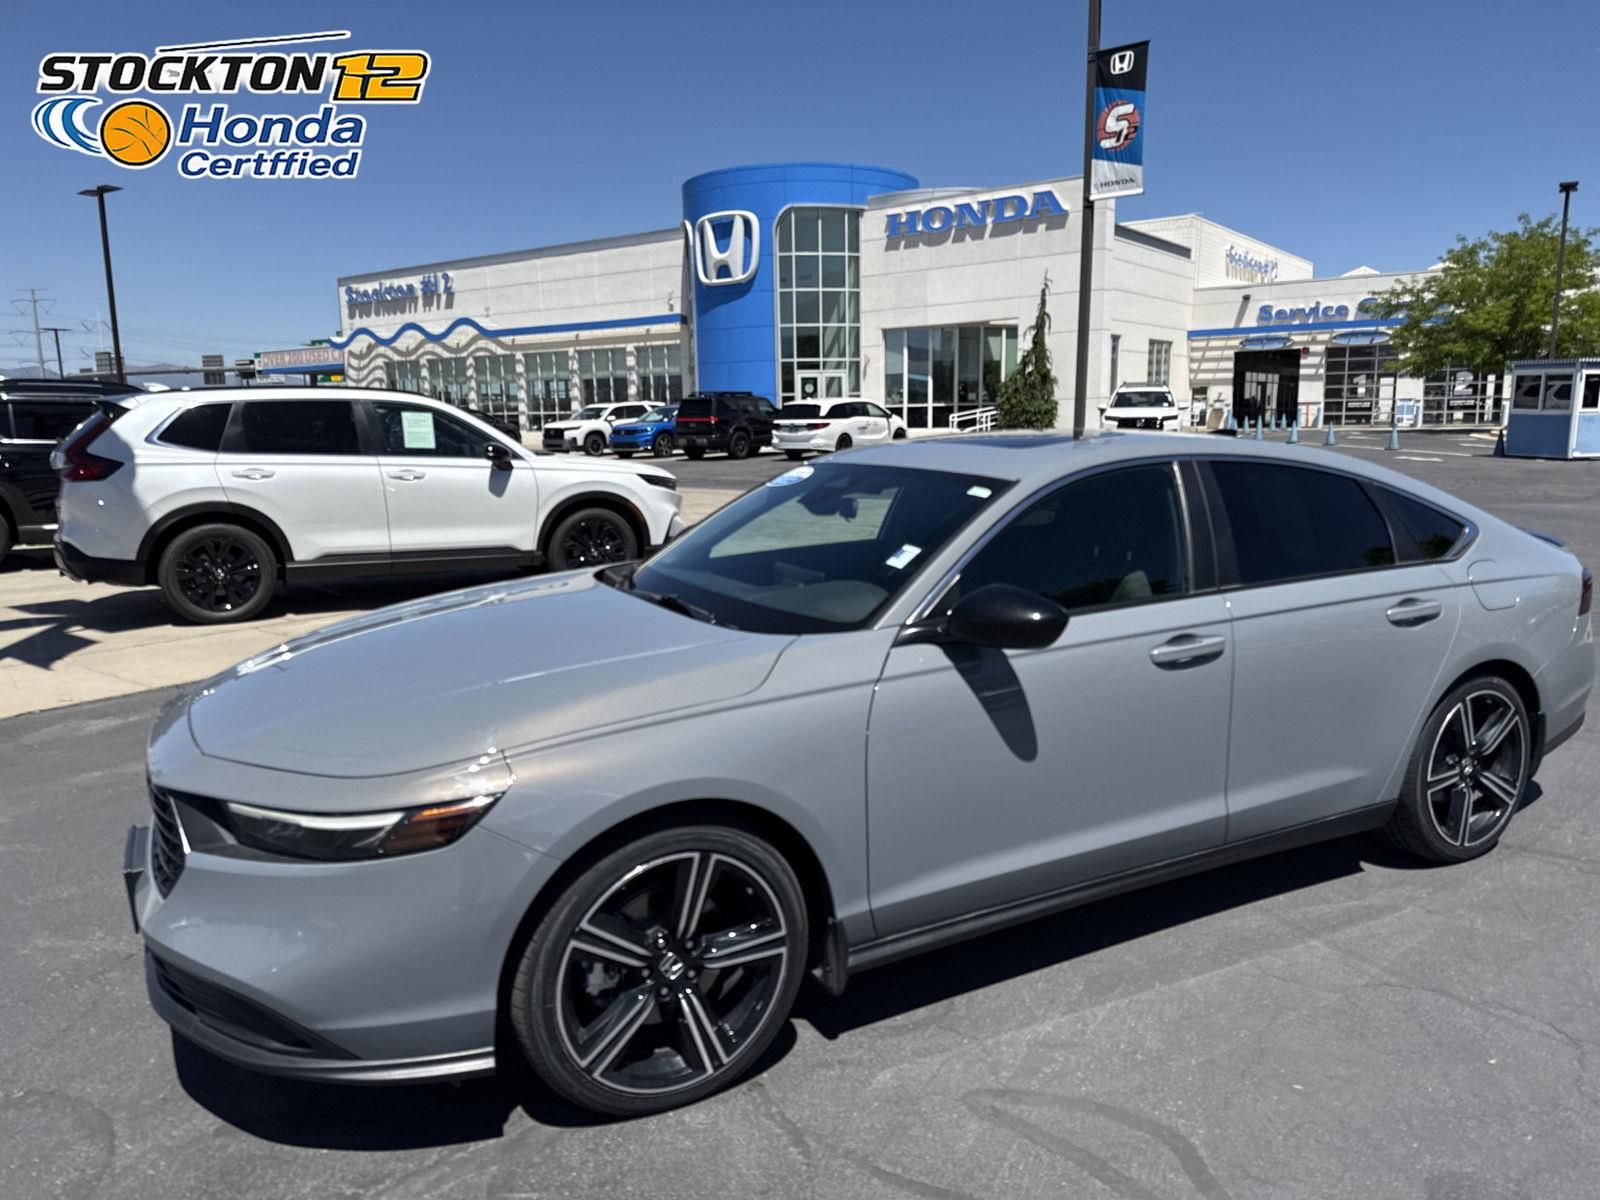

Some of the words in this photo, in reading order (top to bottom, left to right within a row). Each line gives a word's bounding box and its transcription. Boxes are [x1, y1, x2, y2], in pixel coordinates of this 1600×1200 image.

[1100, 177, 1135, 188] HONDA
[886, 190, 1069, 238] HONDA
[1259, 300, 1350, 322] Service
